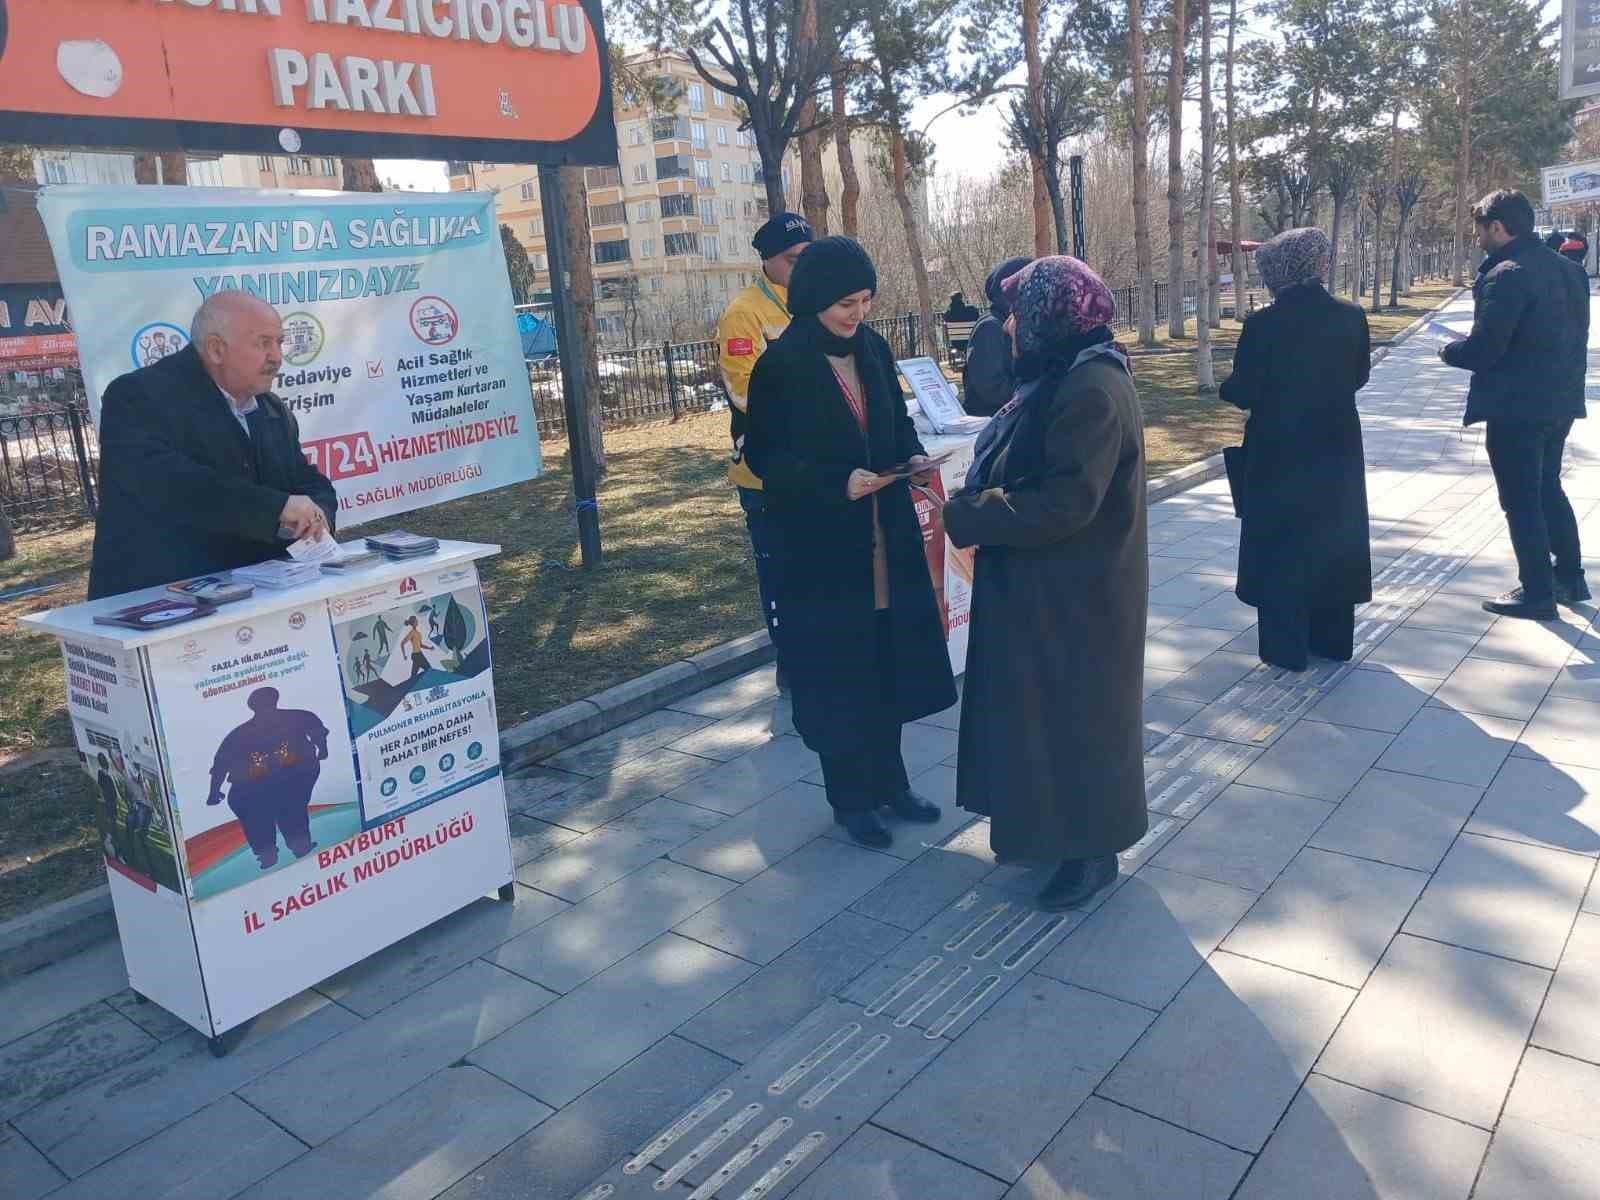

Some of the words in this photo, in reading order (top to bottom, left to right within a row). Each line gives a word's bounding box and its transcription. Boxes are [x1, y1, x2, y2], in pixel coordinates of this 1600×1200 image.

[267, 47, 438, 117] PARKI
[86, 219, 338, 261] RAMAZAN'DA
[276, 365, 352, 388] Tedaviye
[397, 355, 424, 371] Acil
[428, 347, 473, 366] Sağlık
[401, 364, 472, 389] Hizmetleri
[475, 364, 489, 376] ve
[406, 389, 454, 407] Yaşam
[457, 379, 506, 398] Kurtaran
[411, 399, 490, 425] Müdahaleler
[378, 411, 519, 464] HİZMETİNİZDEYİZ
[356, 482, 406, 507] SAĞLIK
[407, 463, 483, 496] MÜDÜRLÜĞÜ
[368, 717, 413, 741] PULMONER
[380, 740, 401, 755] HER
[403, 723, 445, 746] ADIMDA
[446, 711, 475, 729] DAHA
[383, 746, 420, 768] RAHAT
[421, 739, 438, 753] BİR
[439, 725, 472, 745] NEFES!
[316, 816, 407, 870] BAYBURT
[243, 909, 265, 934] İL
[270, 872, 349, 922] SAĞLIK
[353, 810, 475, 884] MÜDÜRLÜĞÜ
